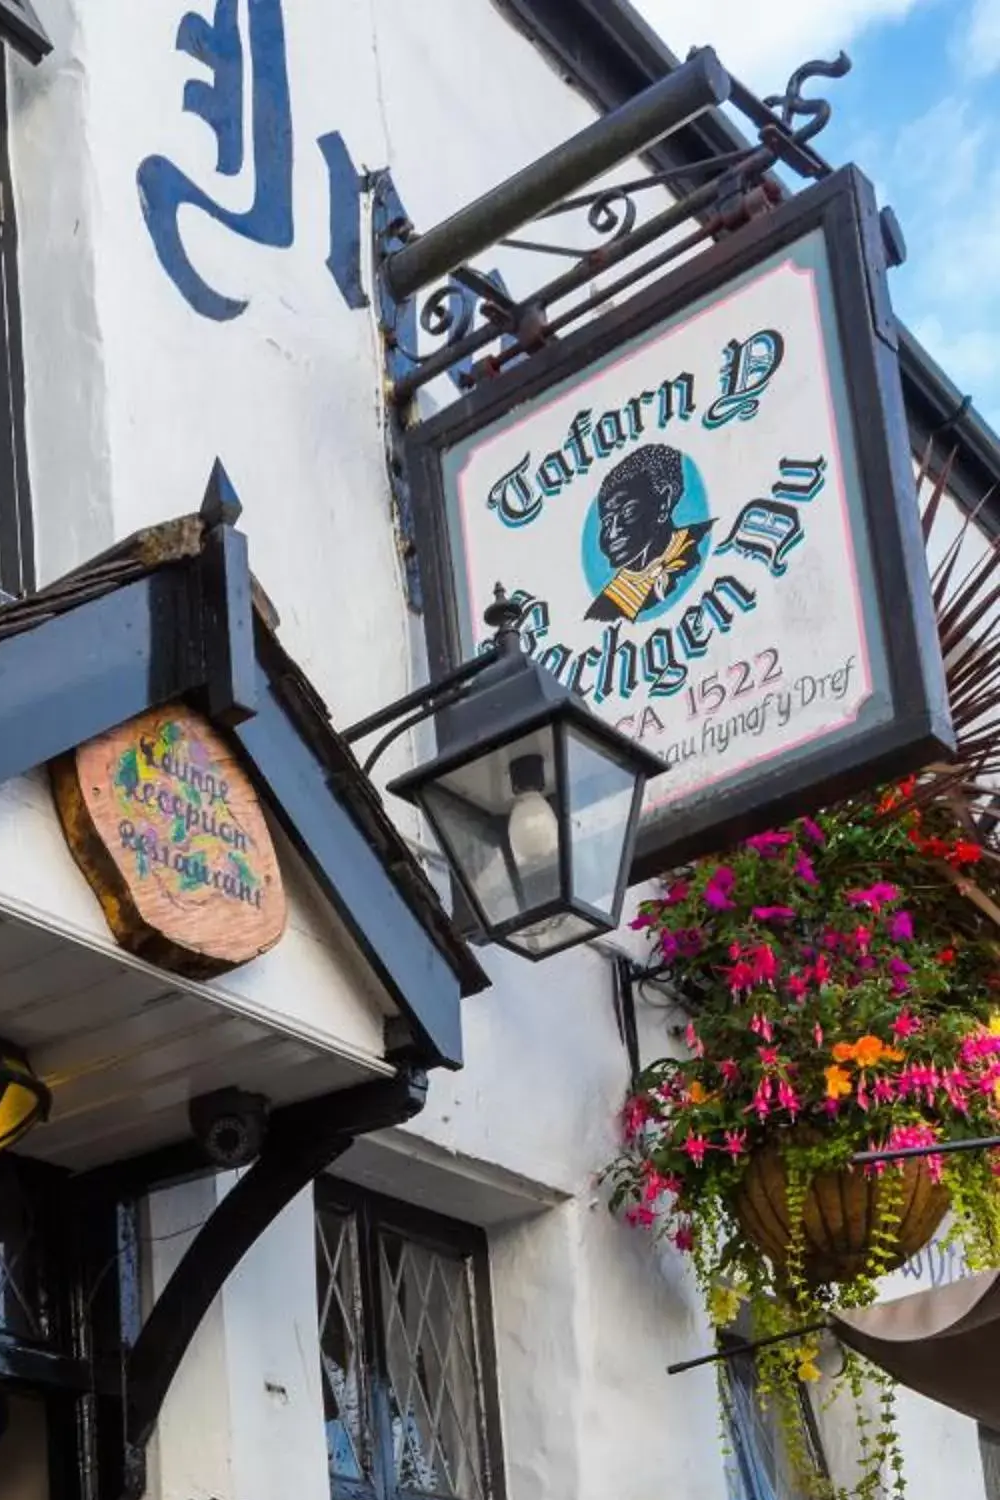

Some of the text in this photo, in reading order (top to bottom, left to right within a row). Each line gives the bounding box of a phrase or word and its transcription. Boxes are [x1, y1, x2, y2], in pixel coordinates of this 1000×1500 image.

[487, 370, 697, 528] Tafarn
[683, 647, 784, 719] 1522
[794, 655, 855, 708] Dref
